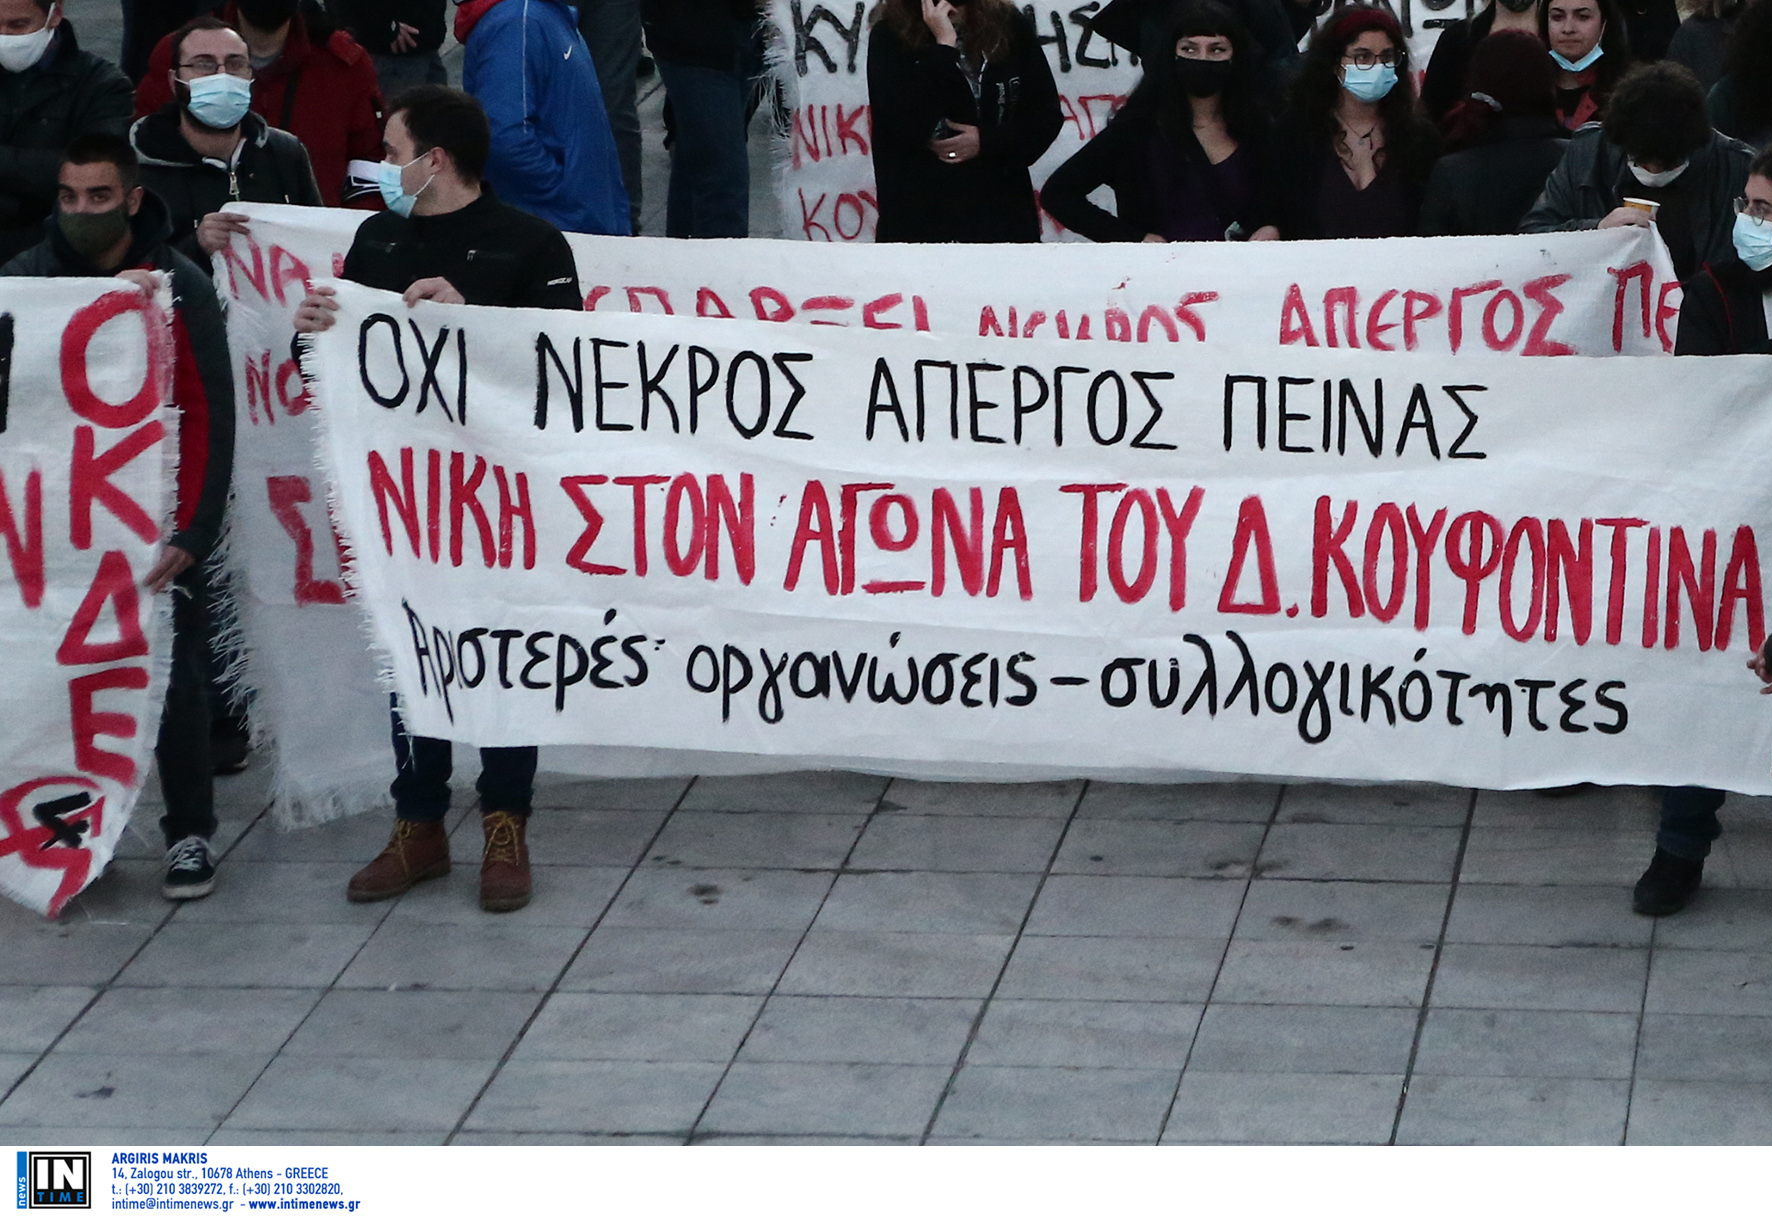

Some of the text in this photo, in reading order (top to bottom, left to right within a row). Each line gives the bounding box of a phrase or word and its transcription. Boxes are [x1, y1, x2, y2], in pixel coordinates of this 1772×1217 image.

[359, 312, 467, 427] ΟΧΙ
[534, 331, 815, 442] ΝΕΚΡΟΣ
[865, 356, 1179, 451] ΑΠΕΡΓΟΣ
[1223, 373, 1488, 461] ΠΕΙΝΑΣ
[367, 445, 536, 571] ΝΙΚΗ
[559, 471, 756, 587] ΣΤΟΝ
[783, 478, 1035, 603] ΑΓΩΝΑ
[1058, 481, 1205, 613] ΤΟΥ
[686, 630, 1038, 725] οργανώσεις
[1100, 630, 1629, 745] συλλογικότητες
